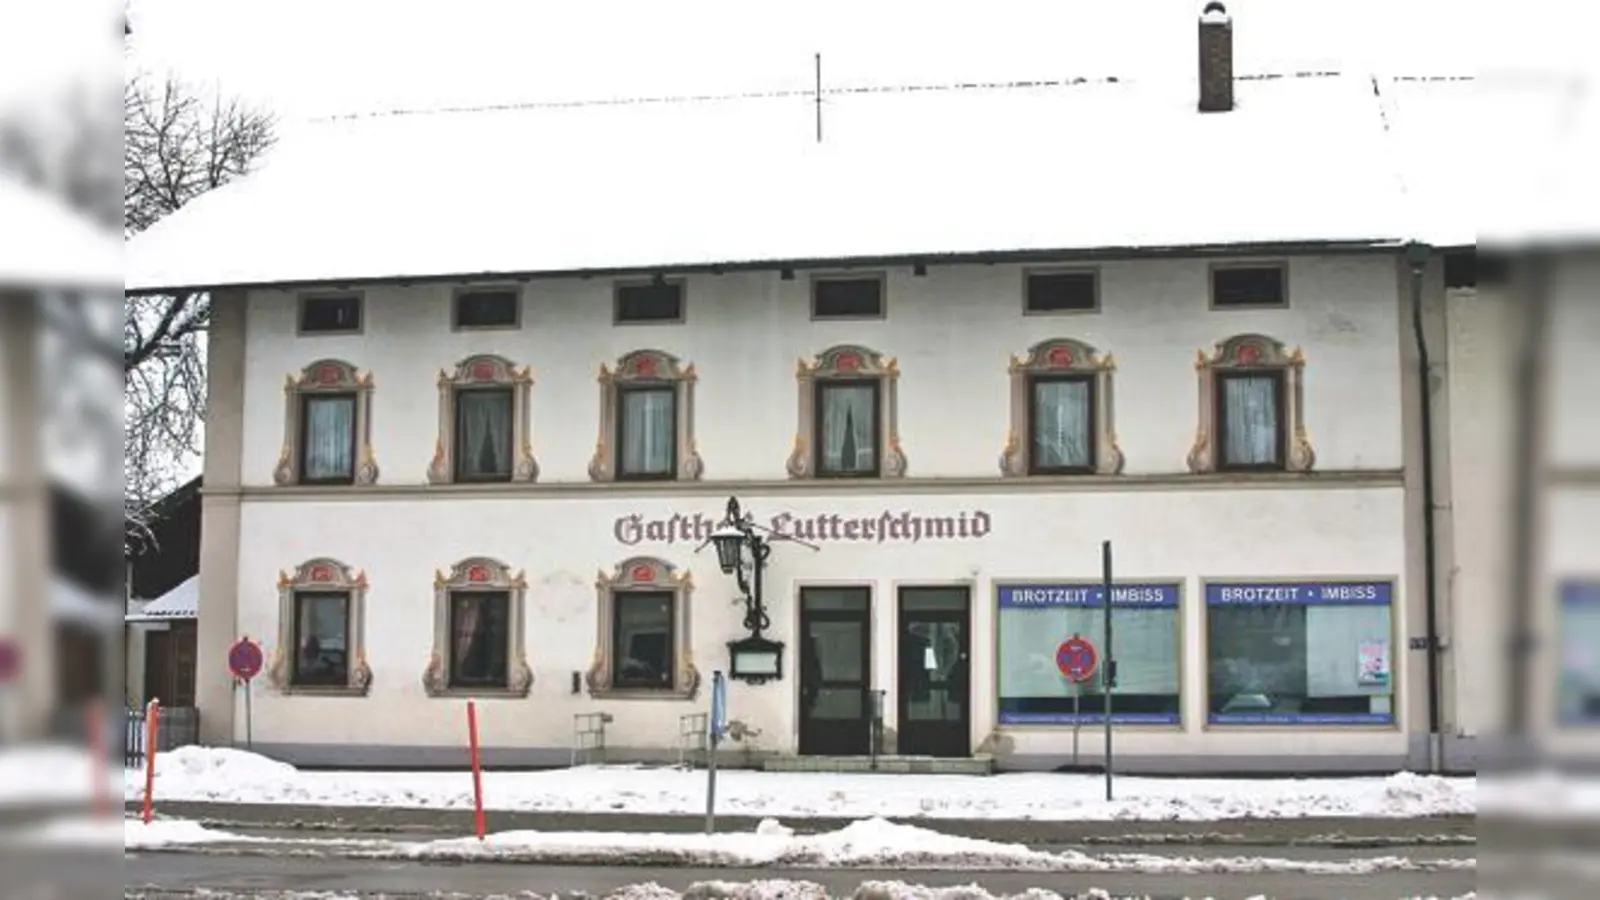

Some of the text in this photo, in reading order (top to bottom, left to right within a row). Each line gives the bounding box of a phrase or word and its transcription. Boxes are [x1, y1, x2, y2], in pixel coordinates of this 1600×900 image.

[614, 510, 991, 545] Gasth Lutterschmid
[1012, 588, 1164, 603] BROTZEIT IMBISS
[1221, 586, 1376, 601] BROTZEIT IMBISS
